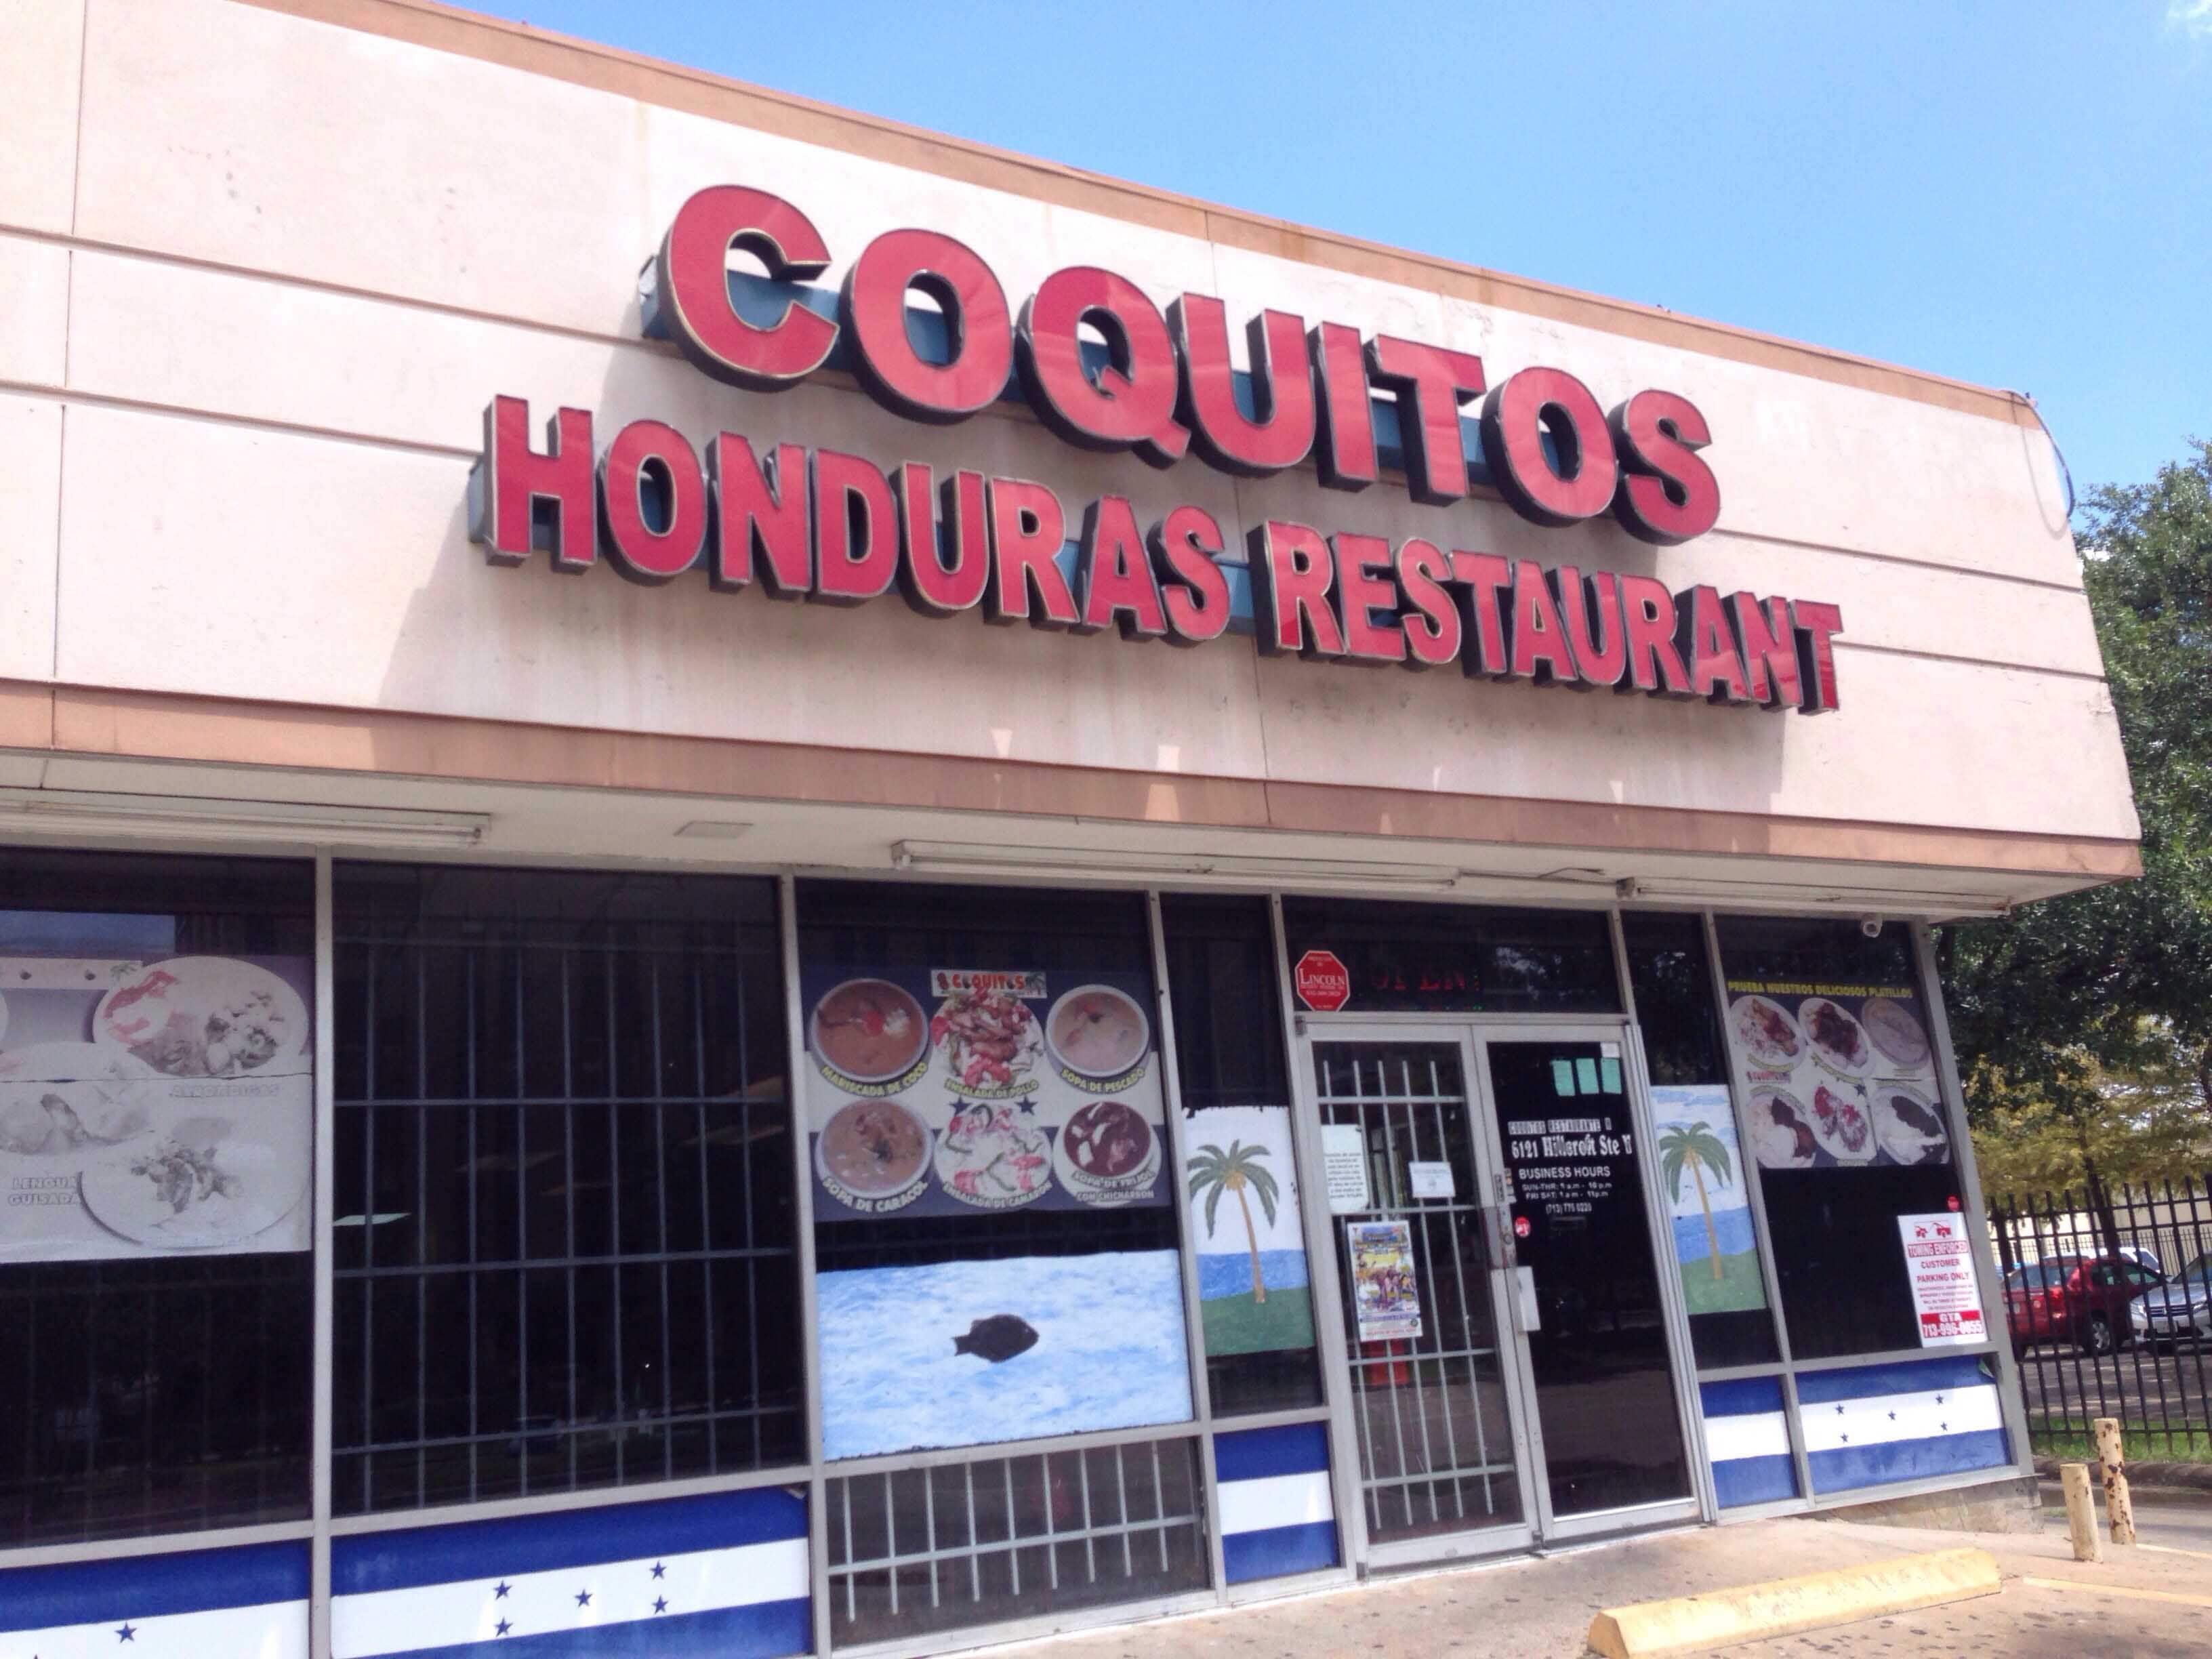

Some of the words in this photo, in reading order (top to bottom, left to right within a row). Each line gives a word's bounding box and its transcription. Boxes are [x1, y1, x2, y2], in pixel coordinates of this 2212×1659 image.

[662, 184, 1720, 544] COQUITOS
[486, 394, 1230, 645] HONDURAS
[1252, 520, 1843, 713] RESTAURANT
[1727, 980, 1765, 993] PRUEBA
[1816, 985, 1867, 997] DELICIOSOS
[1868, 987, 1913, 998] PLATILLOS
[886, 1082, 901, 1094] DE
[902, 1062, 927, 1086] COCO
[1008, 1078, 1040, 1097] POLLO
[1061, 1068, 1087, 1090] SOPA
[1089, 1082, 1102, 1092] DE
[1104, 1067, 1146, 1093] PESCADO
[1511, 1140, 1539, 1160] 6121
[1599, 1134, 1621, 1155] Ste
[1519, 1167, 1572, 1179] BUSINESS
[1574, 1166, 1612, 1177] HOURS
[822, 1177, 854, 1207] SOPA
[855, 1198, 873, 1212] DE
[876, 1181, 928, 1212] CARACOL
[1908, 1243, 1933, 1257] TOWING
[1933, 1241, 1969, 1255] ENFORCED
[1920, 1258, 1961, 1269] CUSTOMER
[1917, 1273, 1949, 1283] PARKING
[1950, 1271, 1970, 1281] ONLY
[1938, 1312, 1963, 1322] GTA
